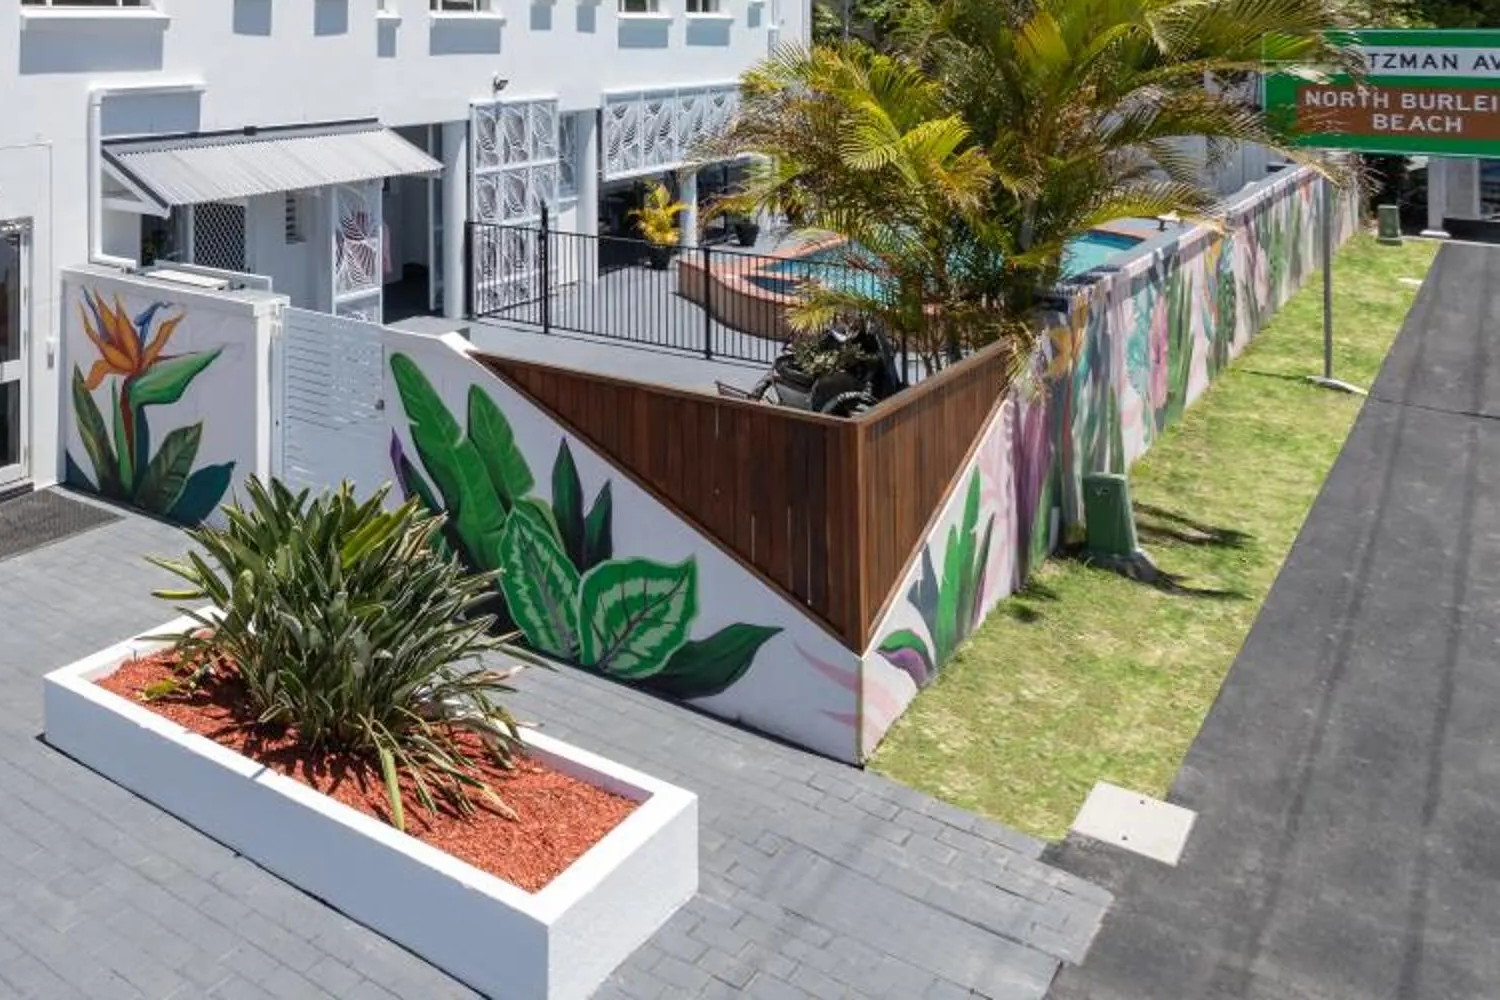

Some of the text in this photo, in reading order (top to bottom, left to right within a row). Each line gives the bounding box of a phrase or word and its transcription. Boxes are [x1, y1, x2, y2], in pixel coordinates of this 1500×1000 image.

[1366, 52, 1458, 70] TZMAN
[1304, 89, 1498, 113] NORTH BURLEI
[1371, 112, 1462, 133] BEACH
